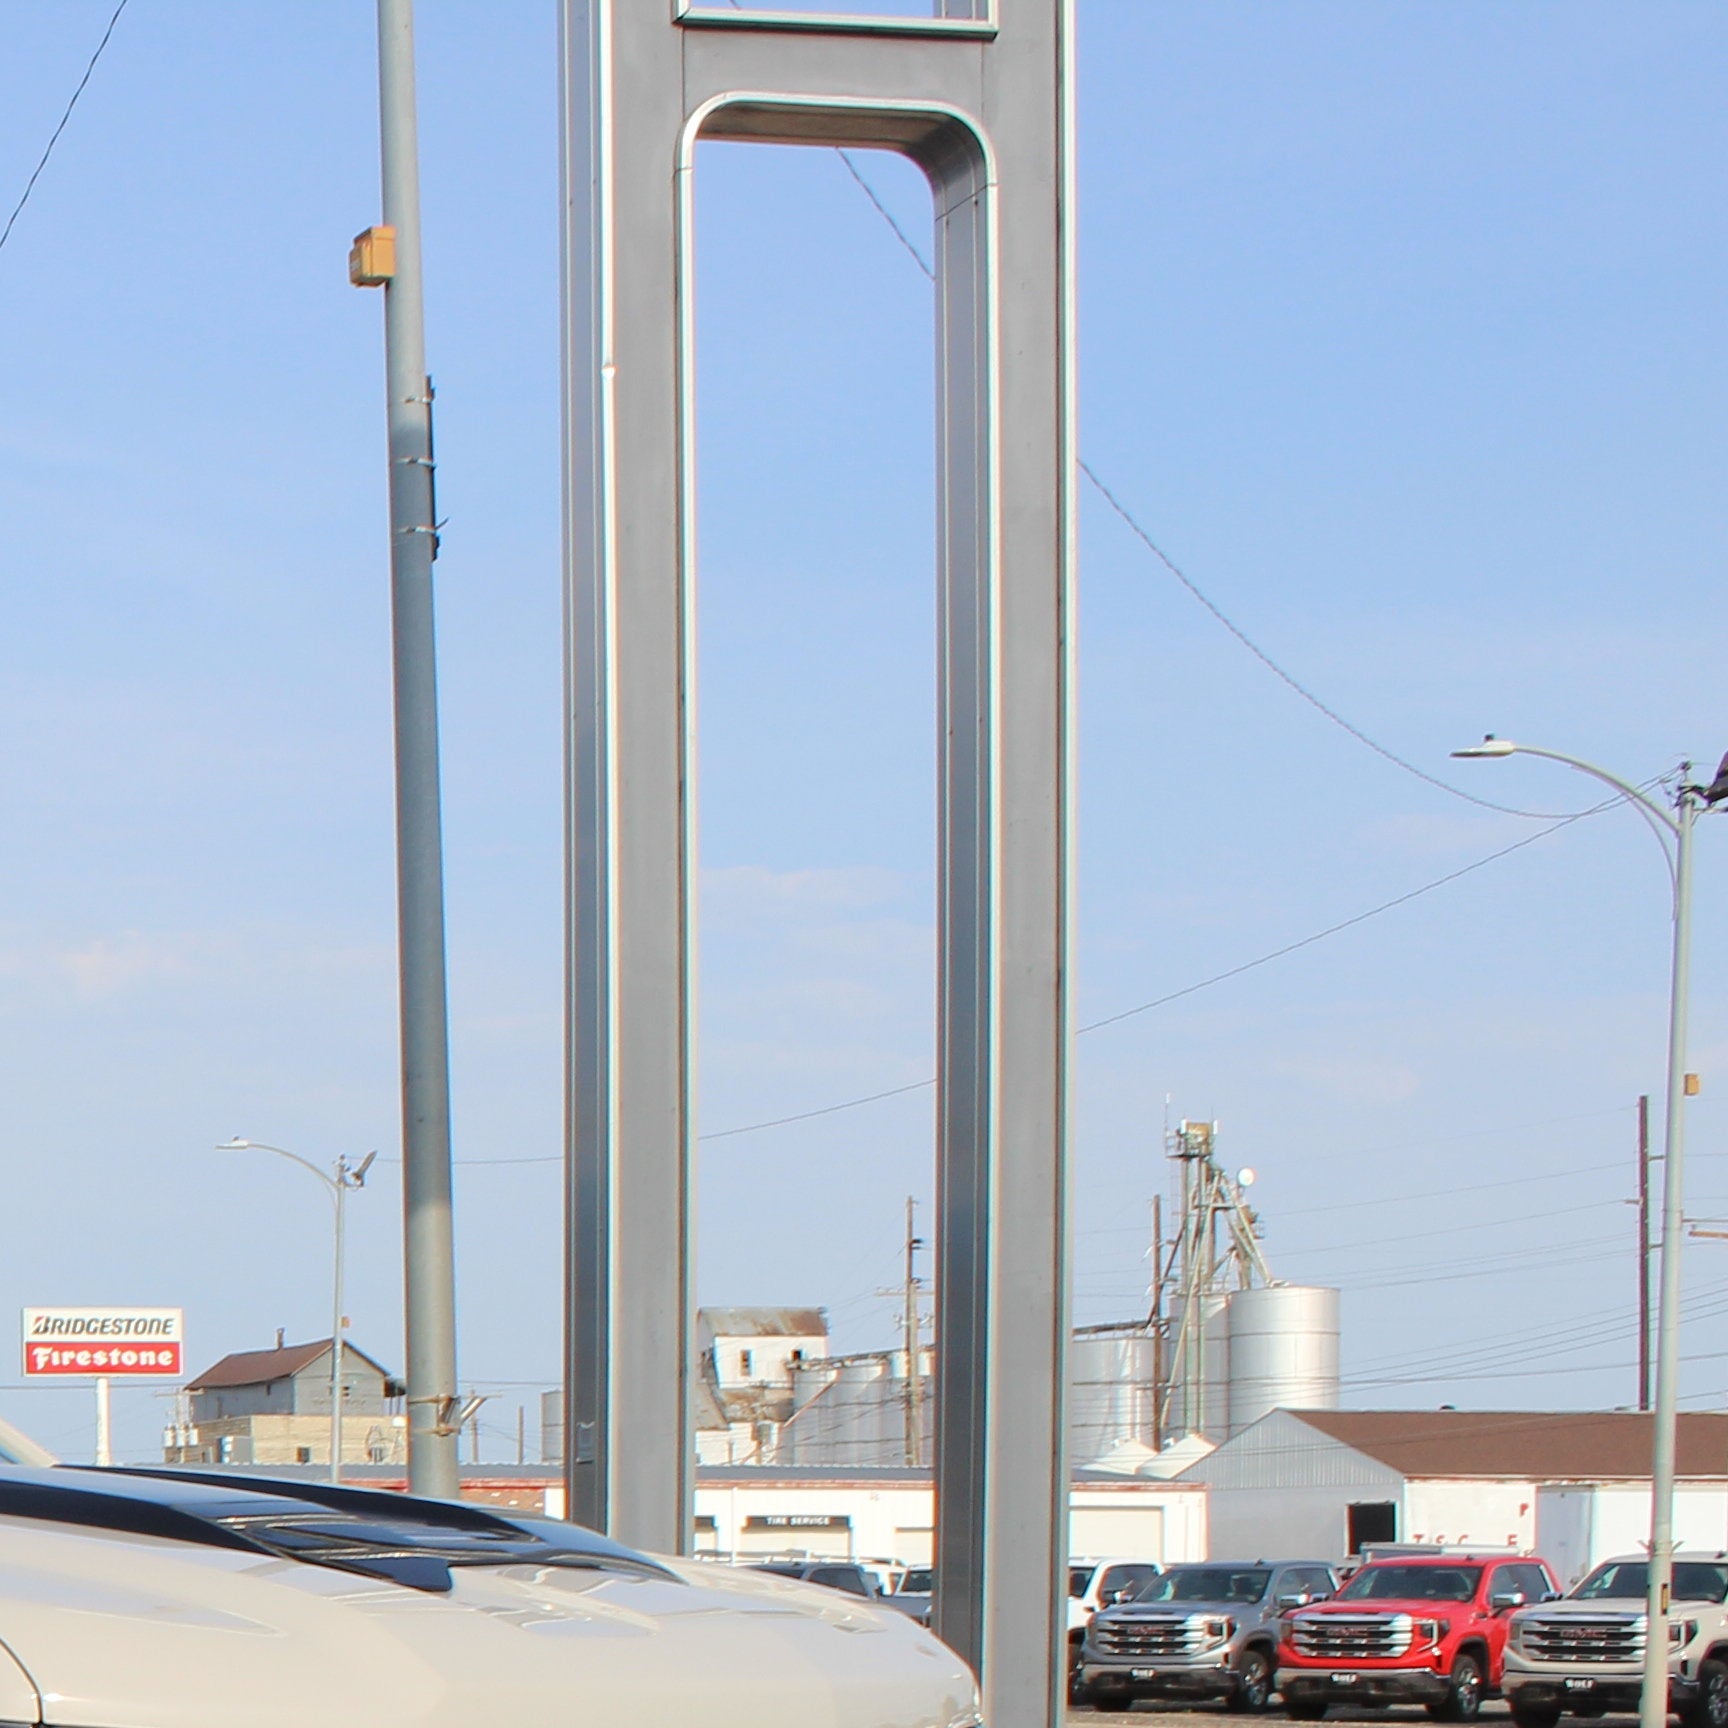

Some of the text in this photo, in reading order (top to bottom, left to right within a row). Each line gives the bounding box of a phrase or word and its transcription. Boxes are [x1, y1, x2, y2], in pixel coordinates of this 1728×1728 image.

[30, 1315, 175, 1337] BRIDGESTONE
[31, 1345, 174, 1371] Firestone
[766, 1516, 831, 1526] TIRE SERVICE
